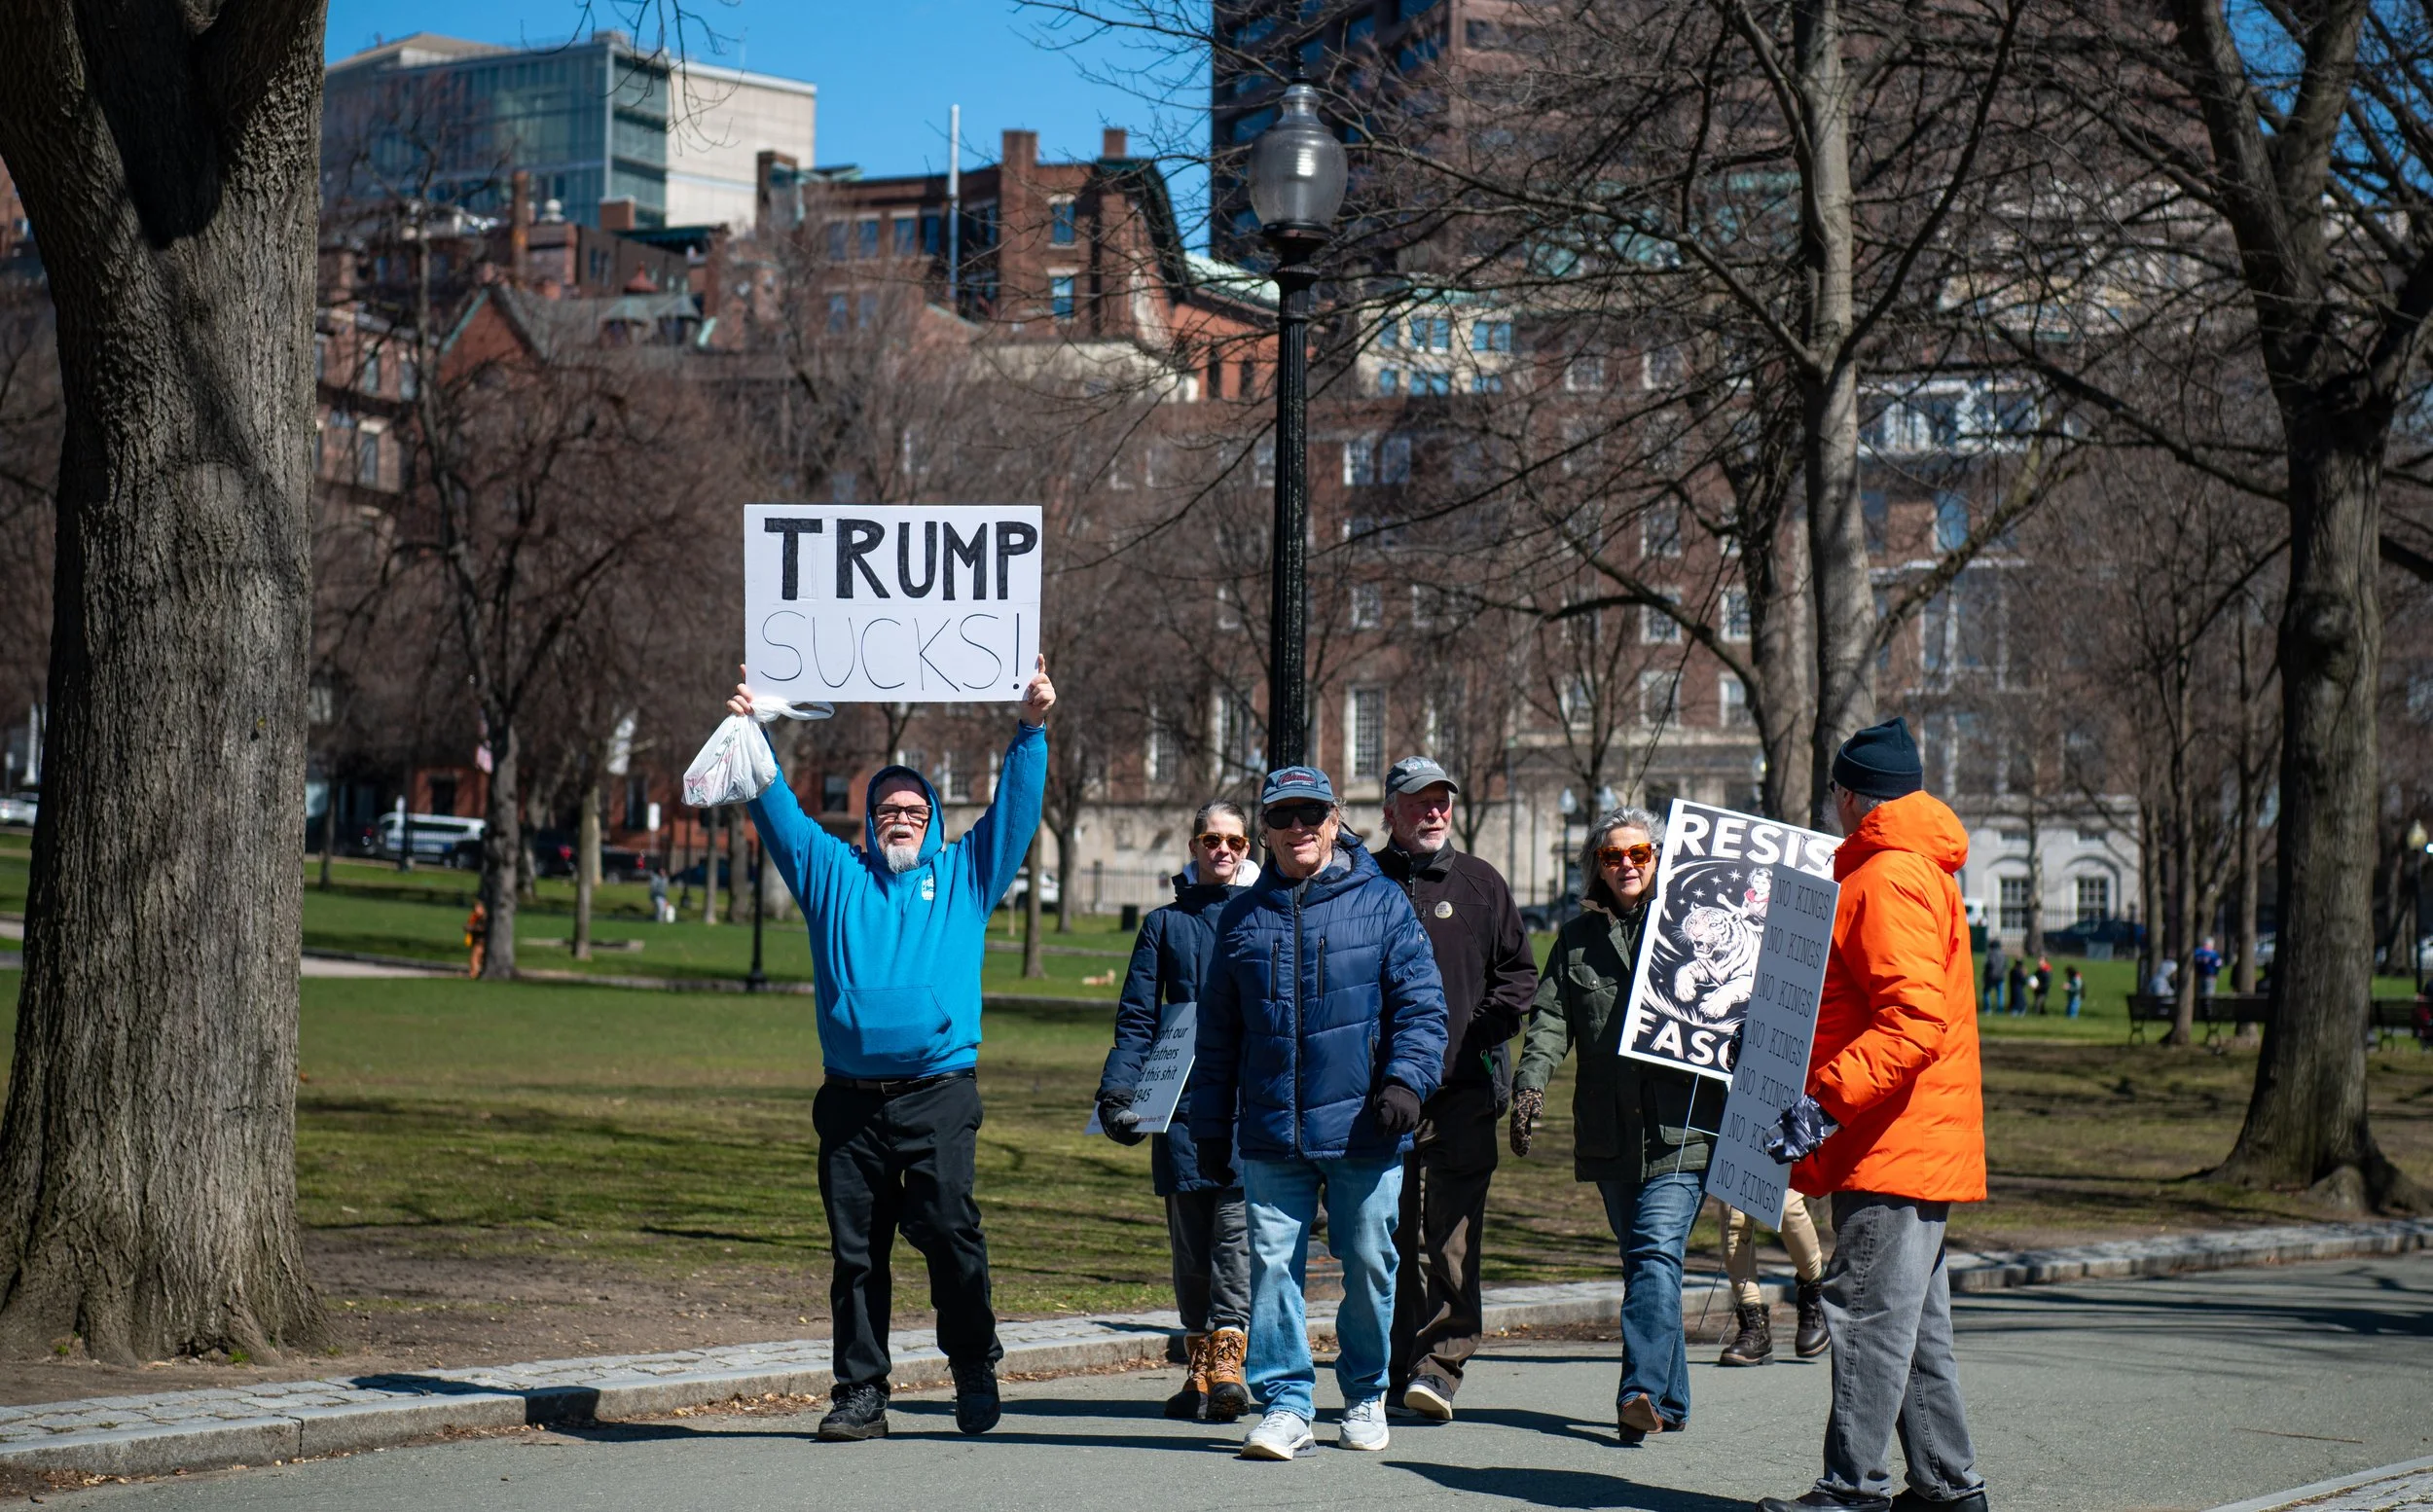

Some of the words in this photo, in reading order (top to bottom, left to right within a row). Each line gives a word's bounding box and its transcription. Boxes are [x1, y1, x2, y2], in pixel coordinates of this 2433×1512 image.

[764, 518, 1038, 601] TRUMP
[760, 610, 1020, 692] SUCKS!
[1775, 879, 1792, 907] NO
[1795, 884, 1831, 920] KINGS
[1766, 925, 1784, 954] NO
[1787, 933, 1822, 969] KINGS
[1758, 973, 1774, 1001] NO
[1777, 980, 1813, 1018] KINGS
[1174, 1027, 1188, 1039] our
[1748, 1020, 1765, 1049] NO
[1768, 1027, 1804, 1066] KINGS
[1144, 1066, 1160, 1082] this
[1160, 1065, 1178, 1081] shit
[1738, 1066, 1756, 1095] NO
[1727, 1113, 1746, 1142] NO
[1716, 1159, 1735, 1189] NO
[1739, 1170, 1778, 1213] KINGS
